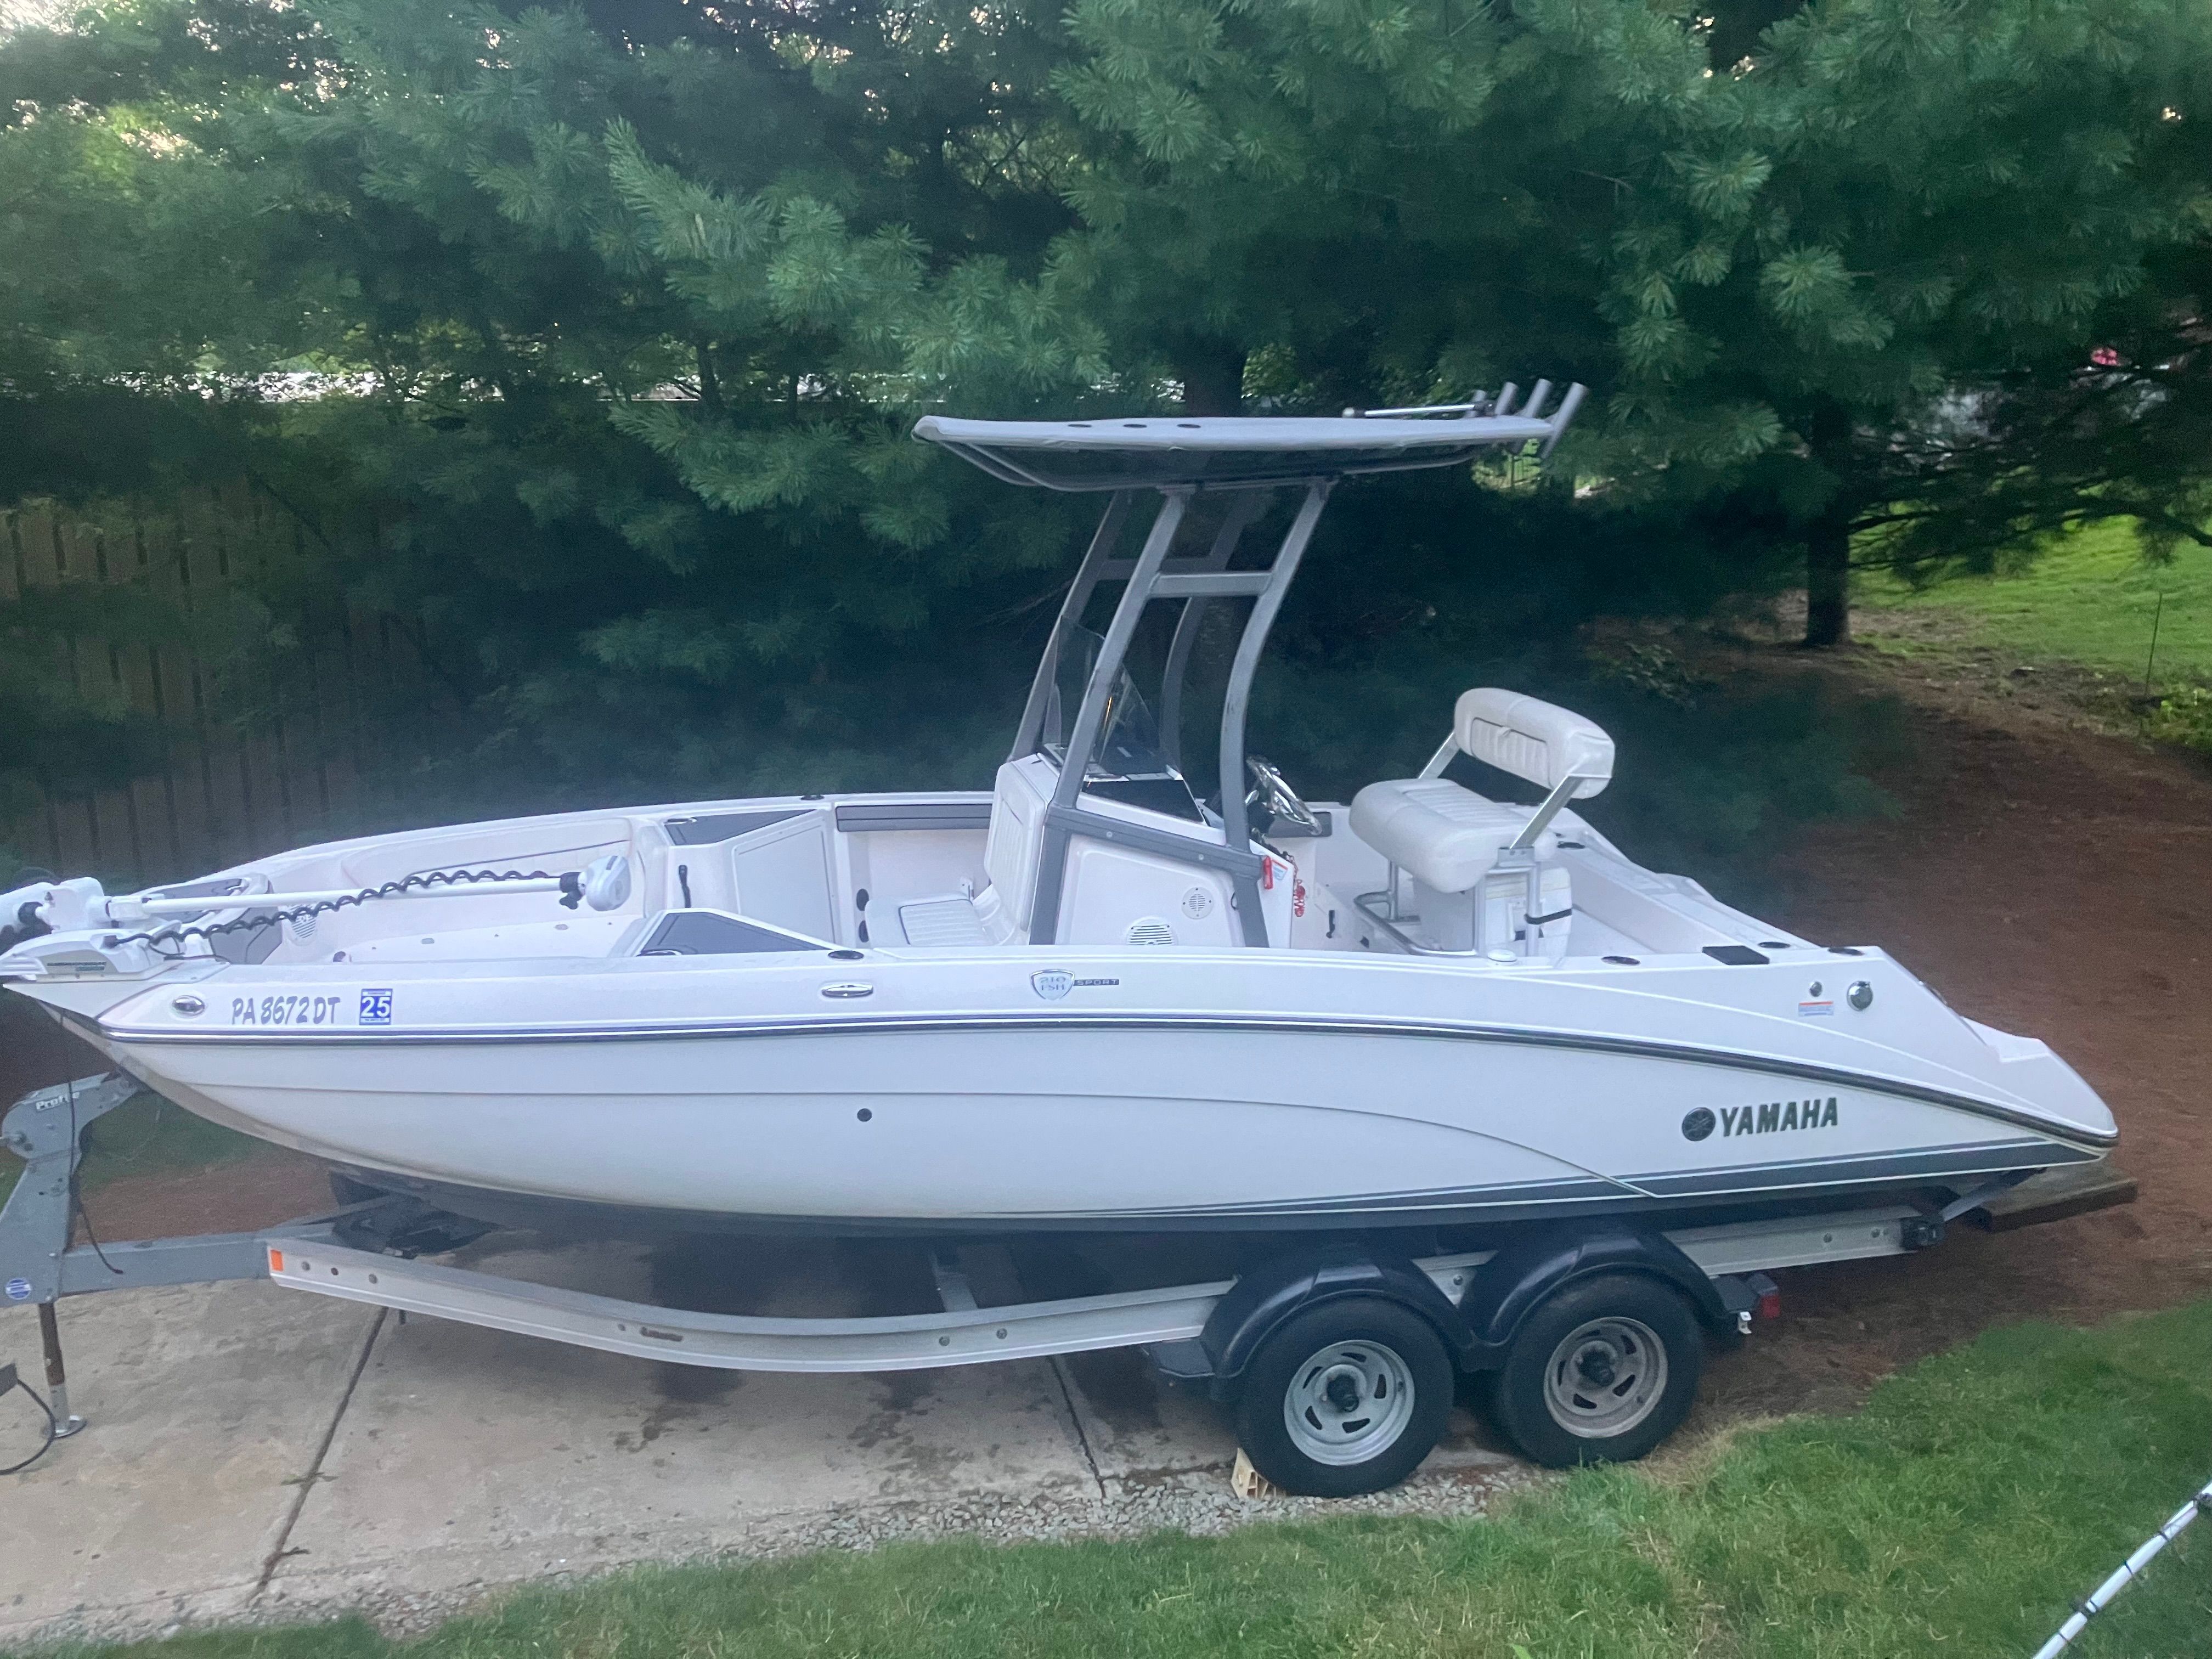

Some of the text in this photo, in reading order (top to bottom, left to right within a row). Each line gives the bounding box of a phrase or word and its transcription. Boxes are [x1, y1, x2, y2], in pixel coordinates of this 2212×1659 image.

[232, 996, 341, 1025] PA 8672 DT
[361, 996, 390, 1017] 25
[1720, 1097, 1838, 1137] YAMAHA
